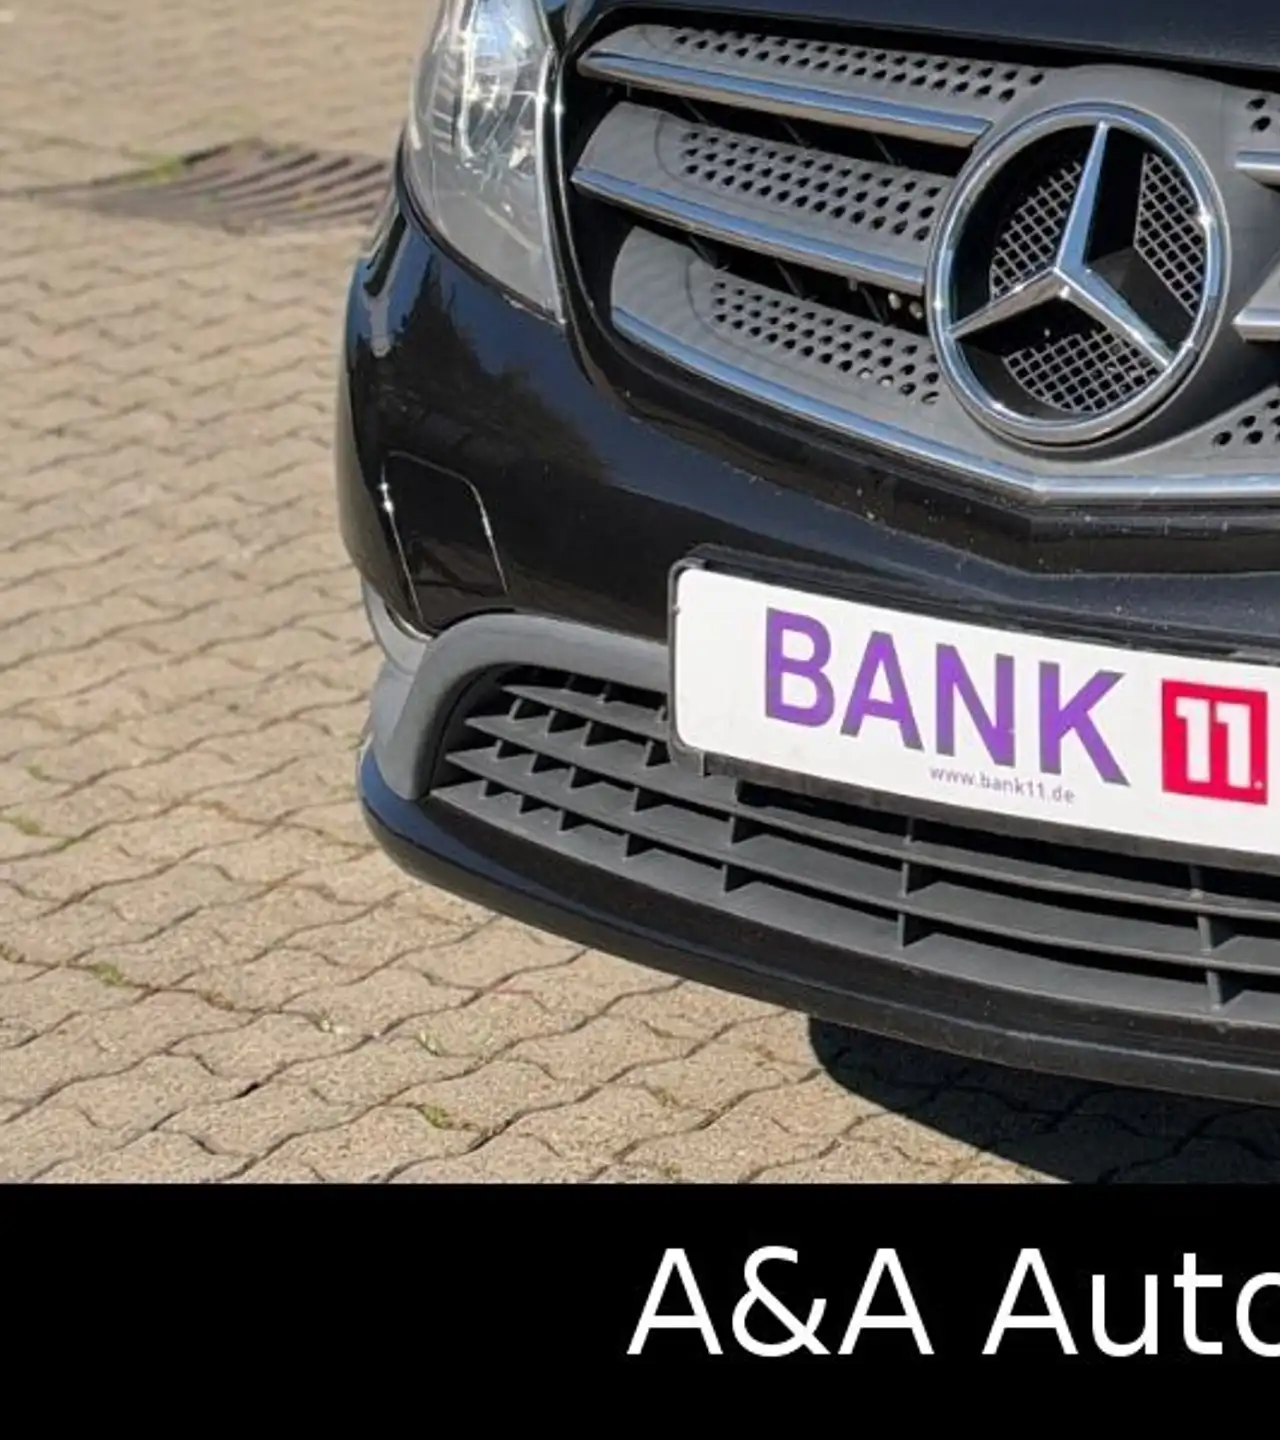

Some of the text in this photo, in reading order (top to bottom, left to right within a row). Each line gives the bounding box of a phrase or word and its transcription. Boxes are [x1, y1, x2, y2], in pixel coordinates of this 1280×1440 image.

[765, 607, 1253, 789] BANK 11
[929, 766, 1075, 804] www.bank11.de
